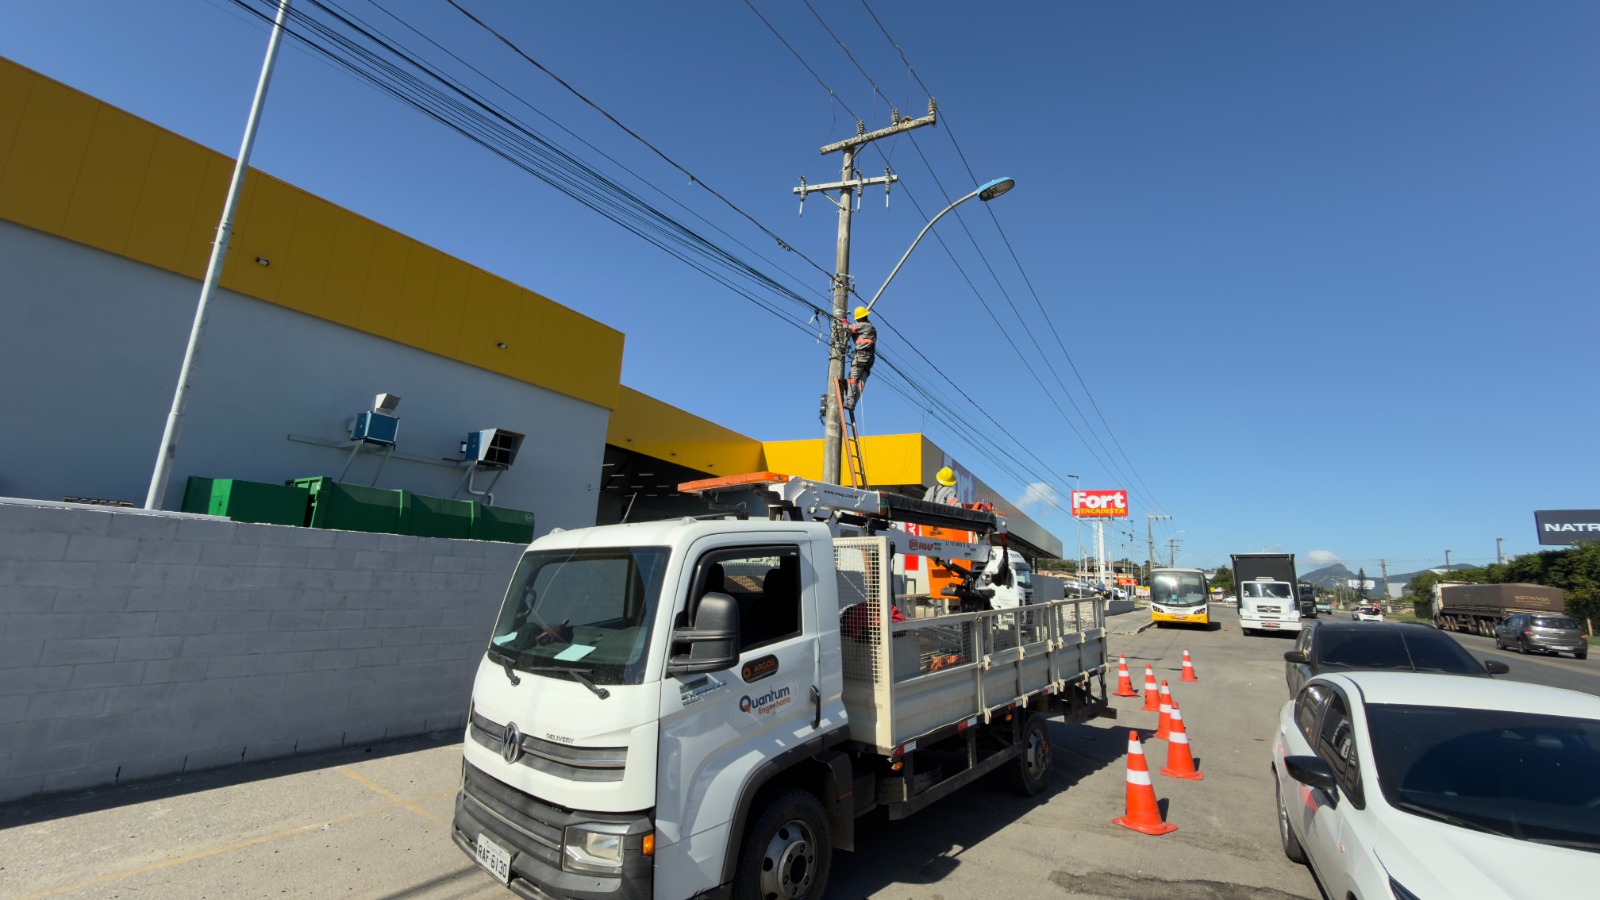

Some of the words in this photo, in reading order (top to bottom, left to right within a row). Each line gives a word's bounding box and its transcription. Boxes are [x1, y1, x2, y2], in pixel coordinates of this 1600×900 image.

[1073, 491, 1126, 509] Fort
[754, 659, 776, 673] ARGOS
[739, 686, 790, 714] Quantum
[758, 698, 791, 715] Engenharia
[546, 732, 575, 744] DELIVERY
